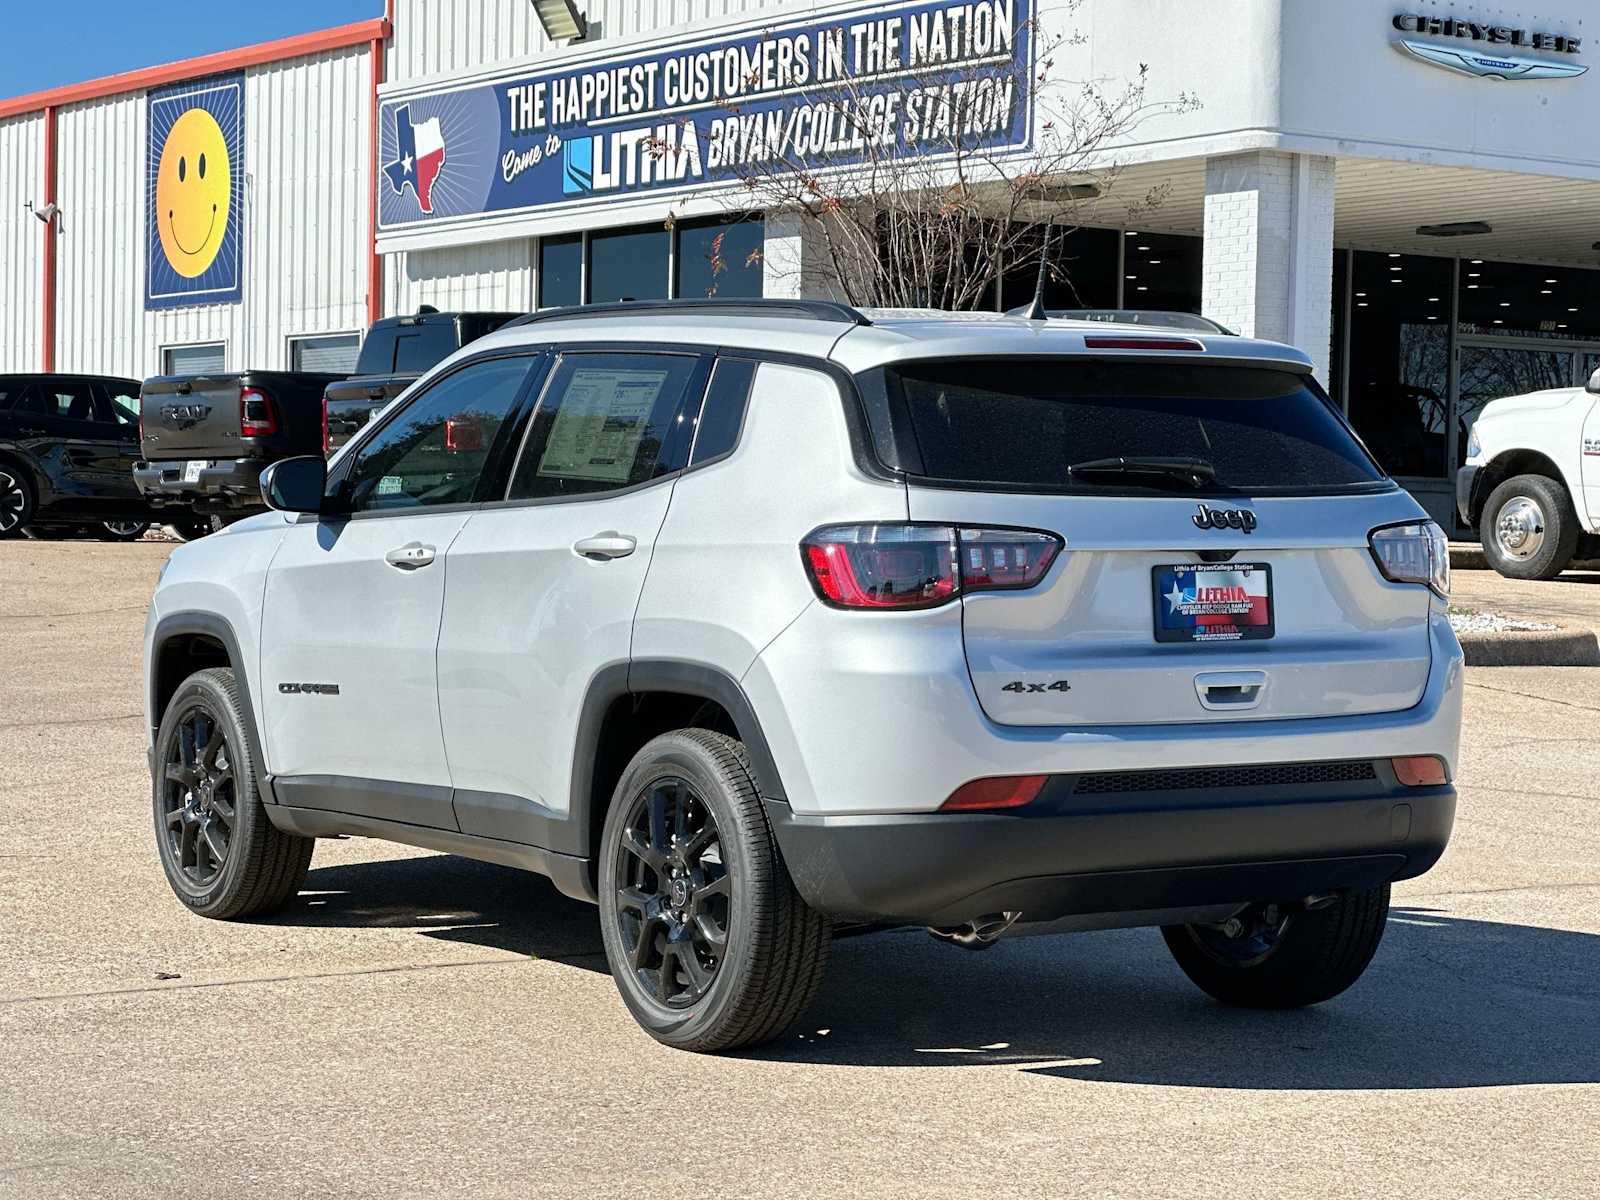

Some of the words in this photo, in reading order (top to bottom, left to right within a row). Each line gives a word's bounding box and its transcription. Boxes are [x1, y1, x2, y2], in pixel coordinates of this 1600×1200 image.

[1393, 14, 1582, 54] CHRYSLER
[507, 82, 546, 132] THE
[552, 62, 659, 125] HAPPIEST
[664, 34, 810, 107] CUSTOMERS
[817, 28, 844, 81] IN
[851, 17, 902, 75] THE
[909, 0, 1013, 66] NATION
[502, 143, 543, 183] Come
[545, 133, 562, 156] to
[593, 120, 703, 191] LITHIA
[707, 92, 900, 169] BRYAN/COLLEGE
[903, 75, 1012, 145] STATION
[1192, 504, 1257, 535] Jeep
[1197, 586, 1250, 603] LITHIA
[1206, 624, 1239, 634] LITHIA
[1001, 680, 1072, 693] 4x4
